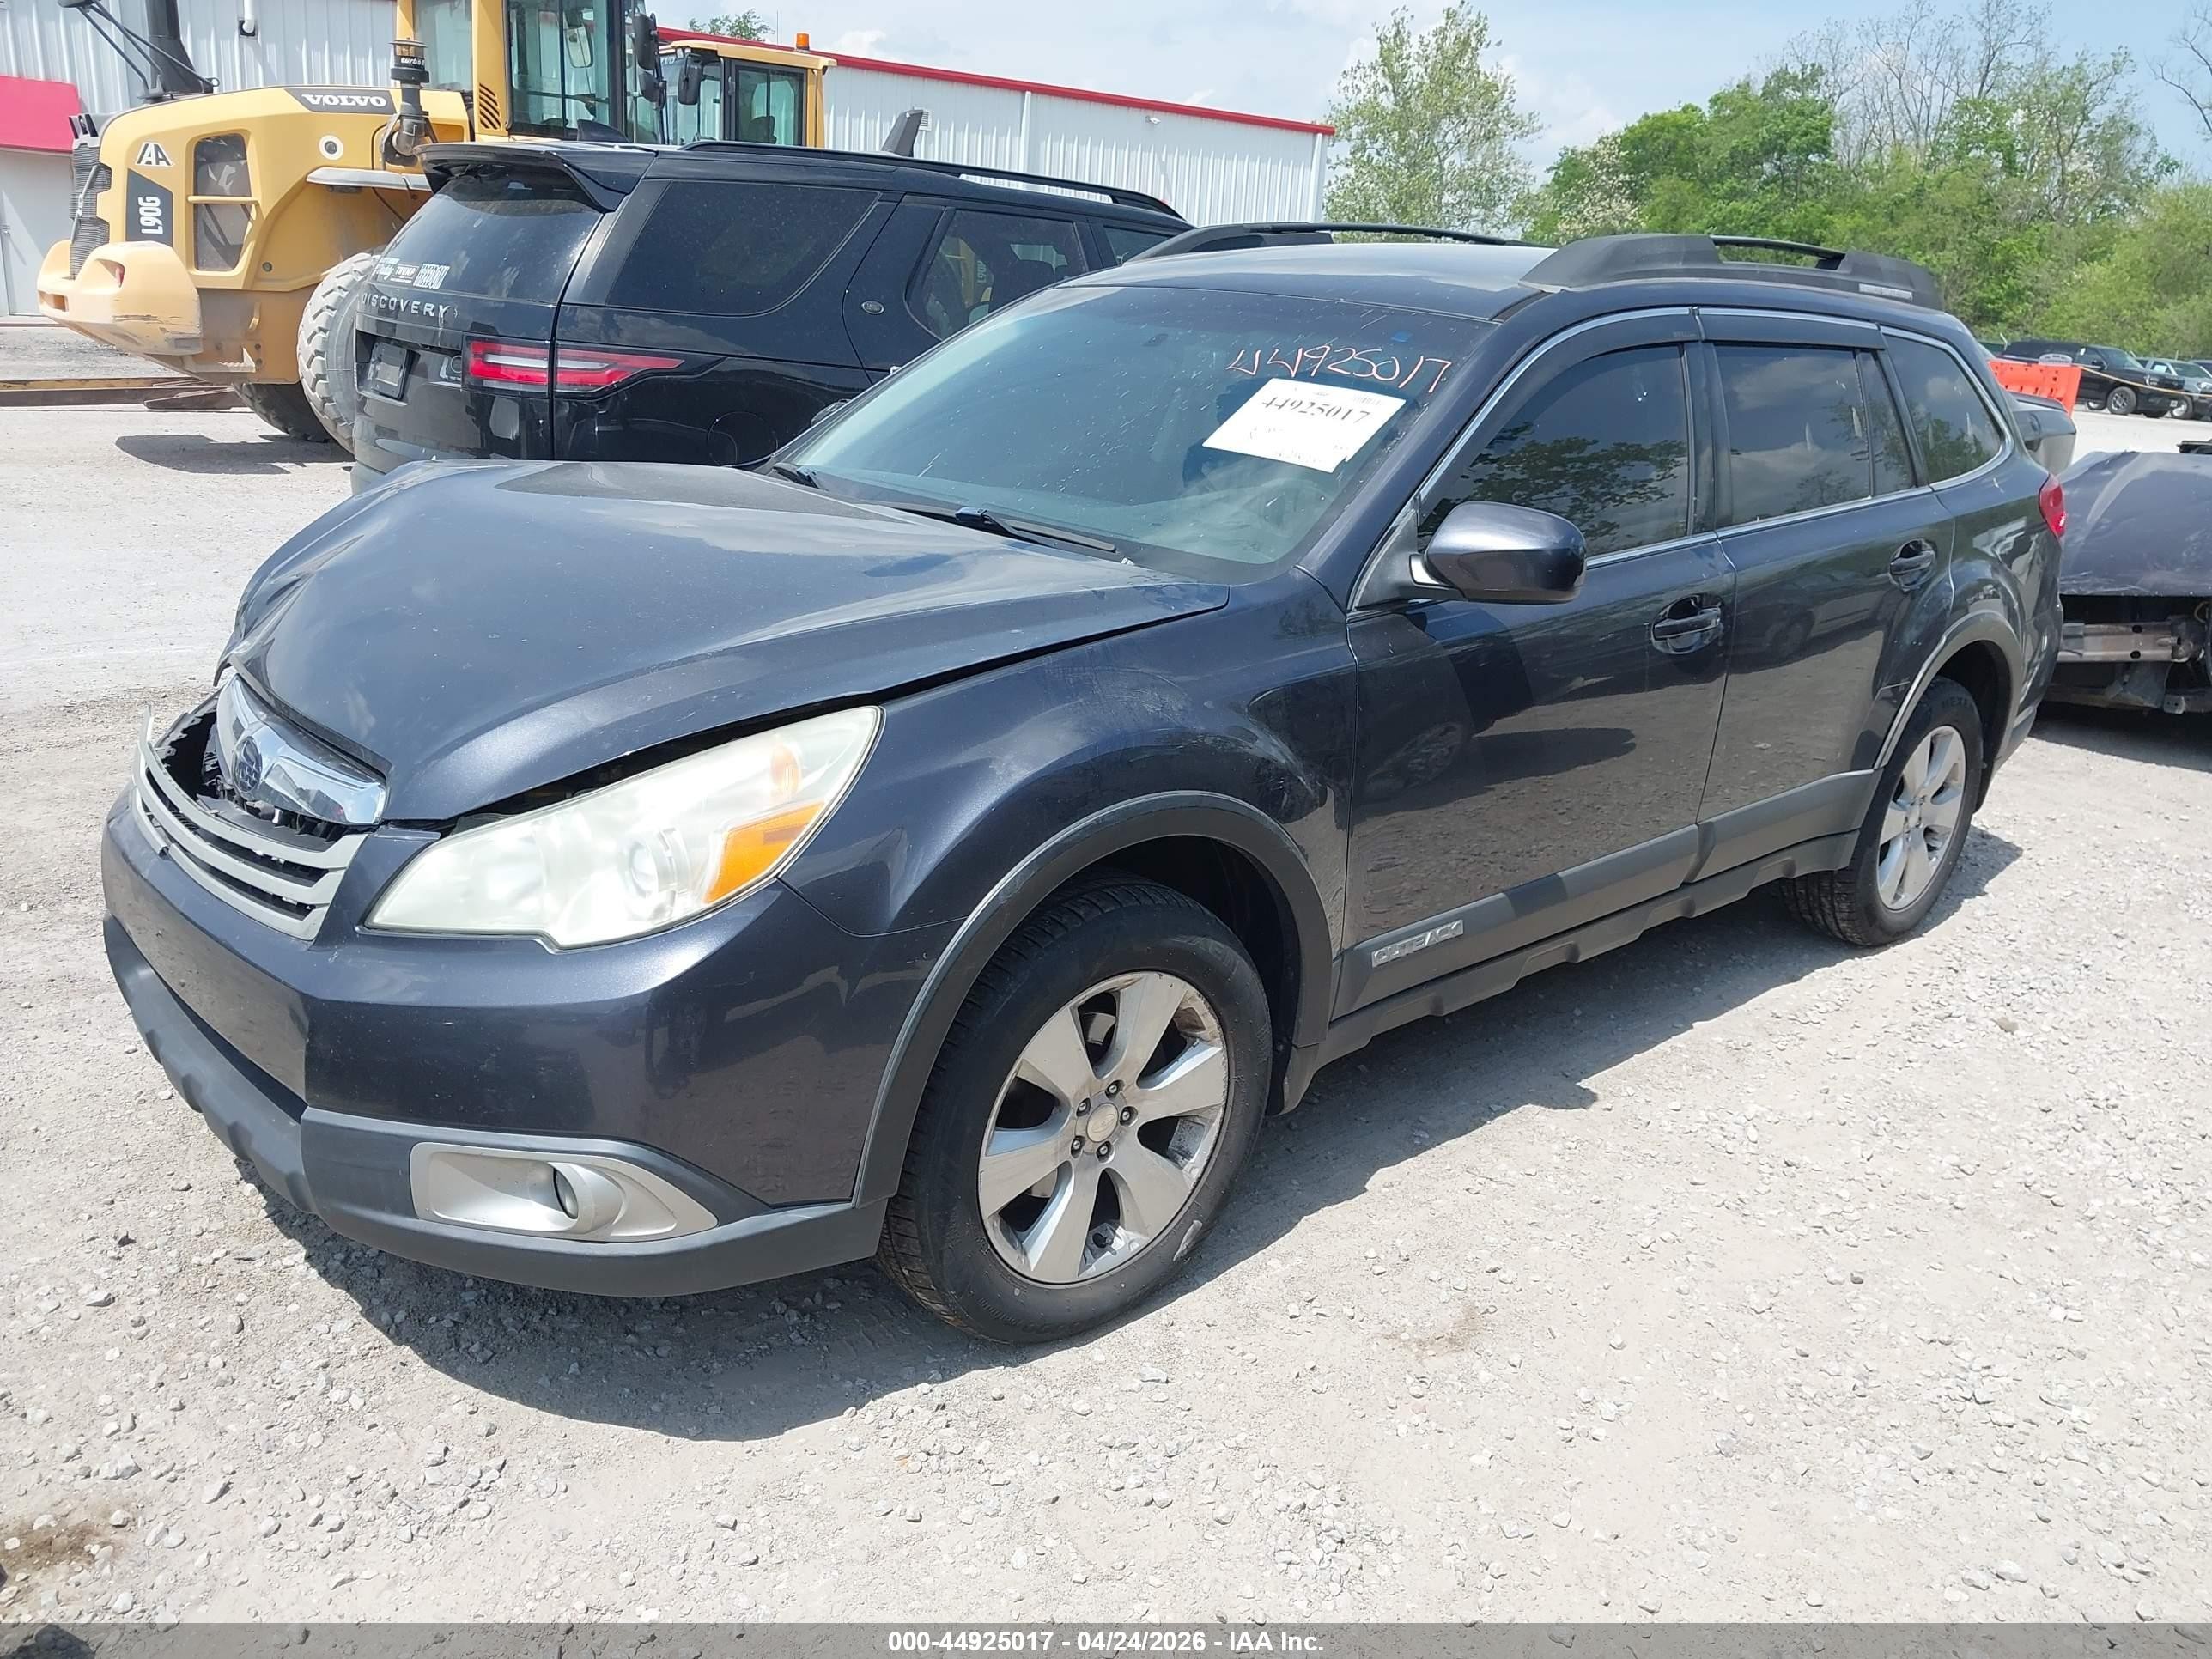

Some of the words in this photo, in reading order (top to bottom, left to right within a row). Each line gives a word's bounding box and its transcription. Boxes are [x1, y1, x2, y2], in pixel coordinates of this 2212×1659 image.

[301, 94, 386, 107] VOLVO
[137, 196, 164, 234] L90G
[362, 293, 451, 319] DISCOVERY
[1226, 345, 1453, 393] 44925017
[1261, 396, 1371, 423] 44925017
